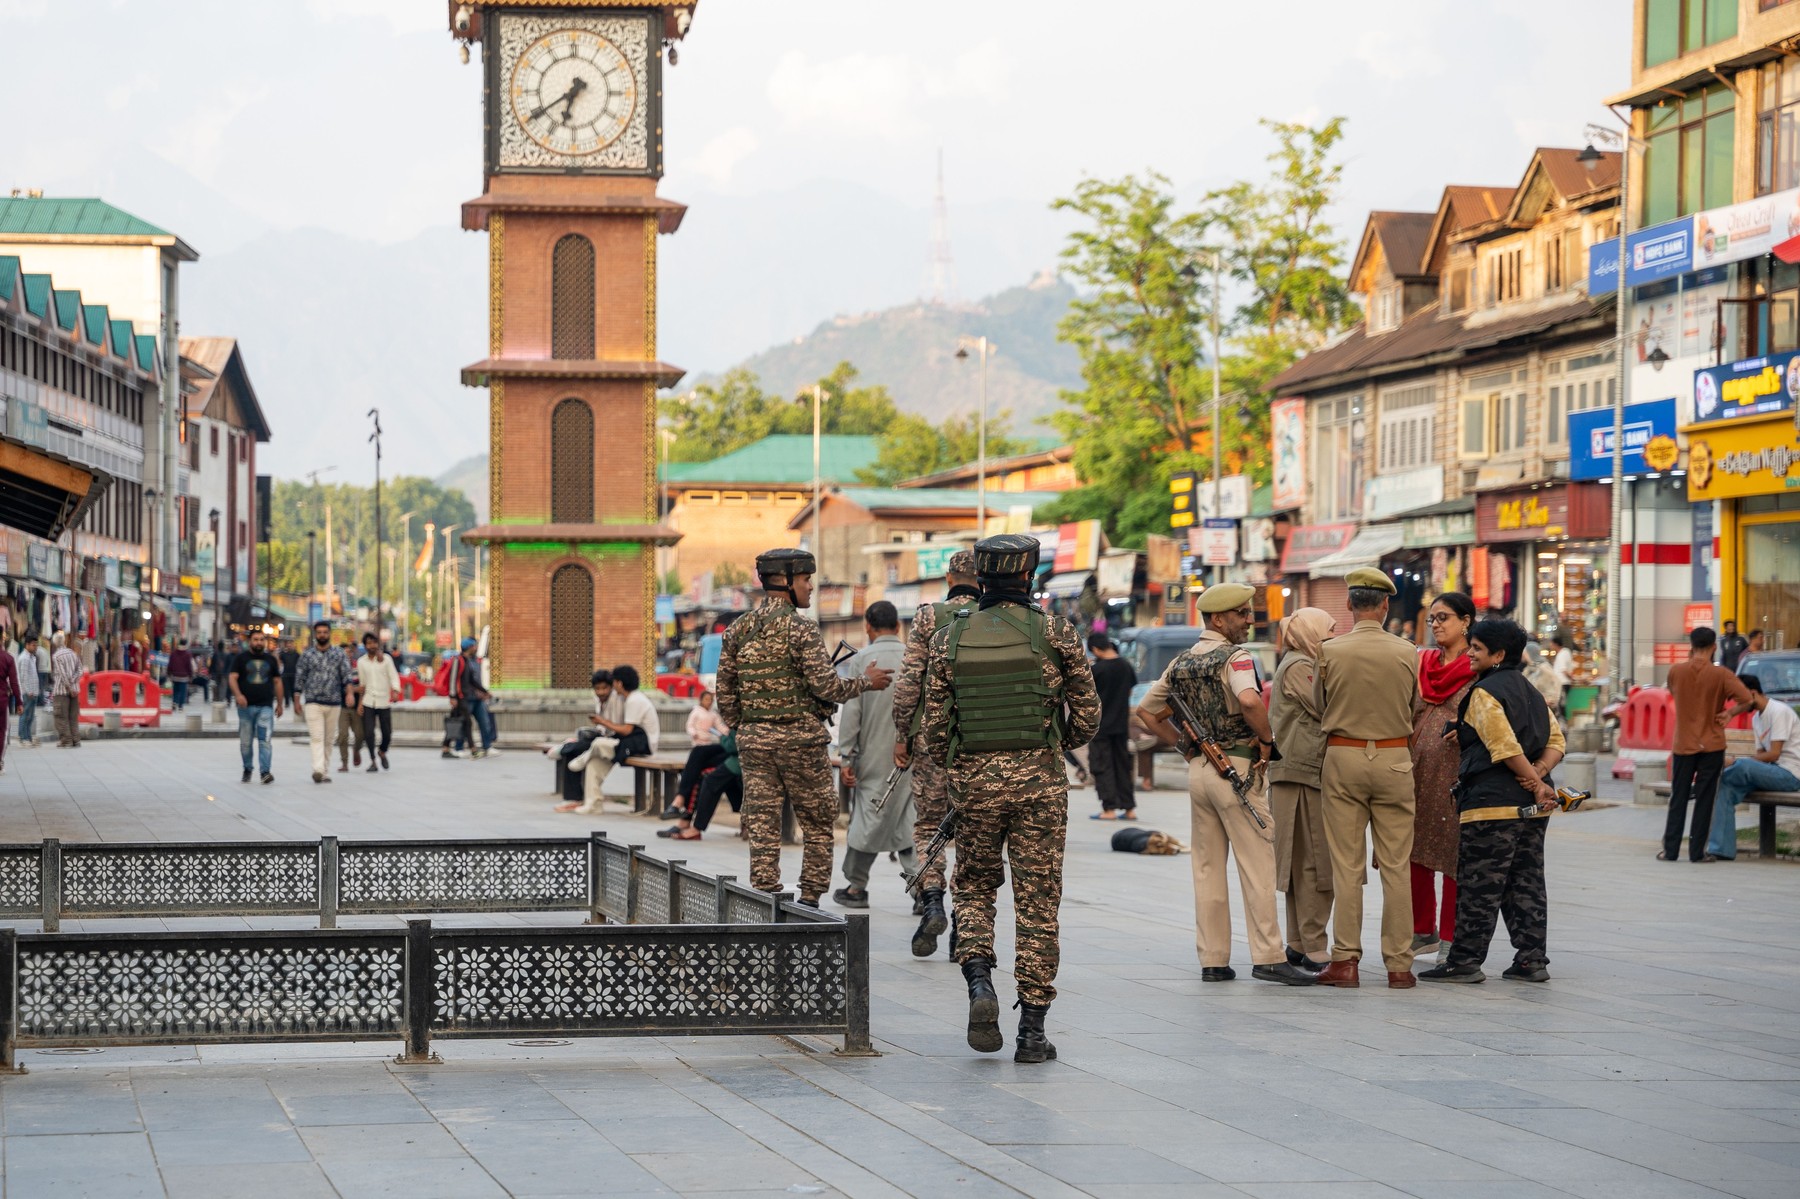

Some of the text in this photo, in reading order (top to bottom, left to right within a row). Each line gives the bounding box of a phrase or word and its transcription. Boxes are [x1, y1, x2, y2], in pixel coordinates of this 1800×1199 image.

[1645, 238, 1684, 261] HDFC BANK
[1626, 429, 1649, 447] BANK
[1726, 451, 1761, 477] Belgian
[1761, 446, 1792, 477] Waffle
